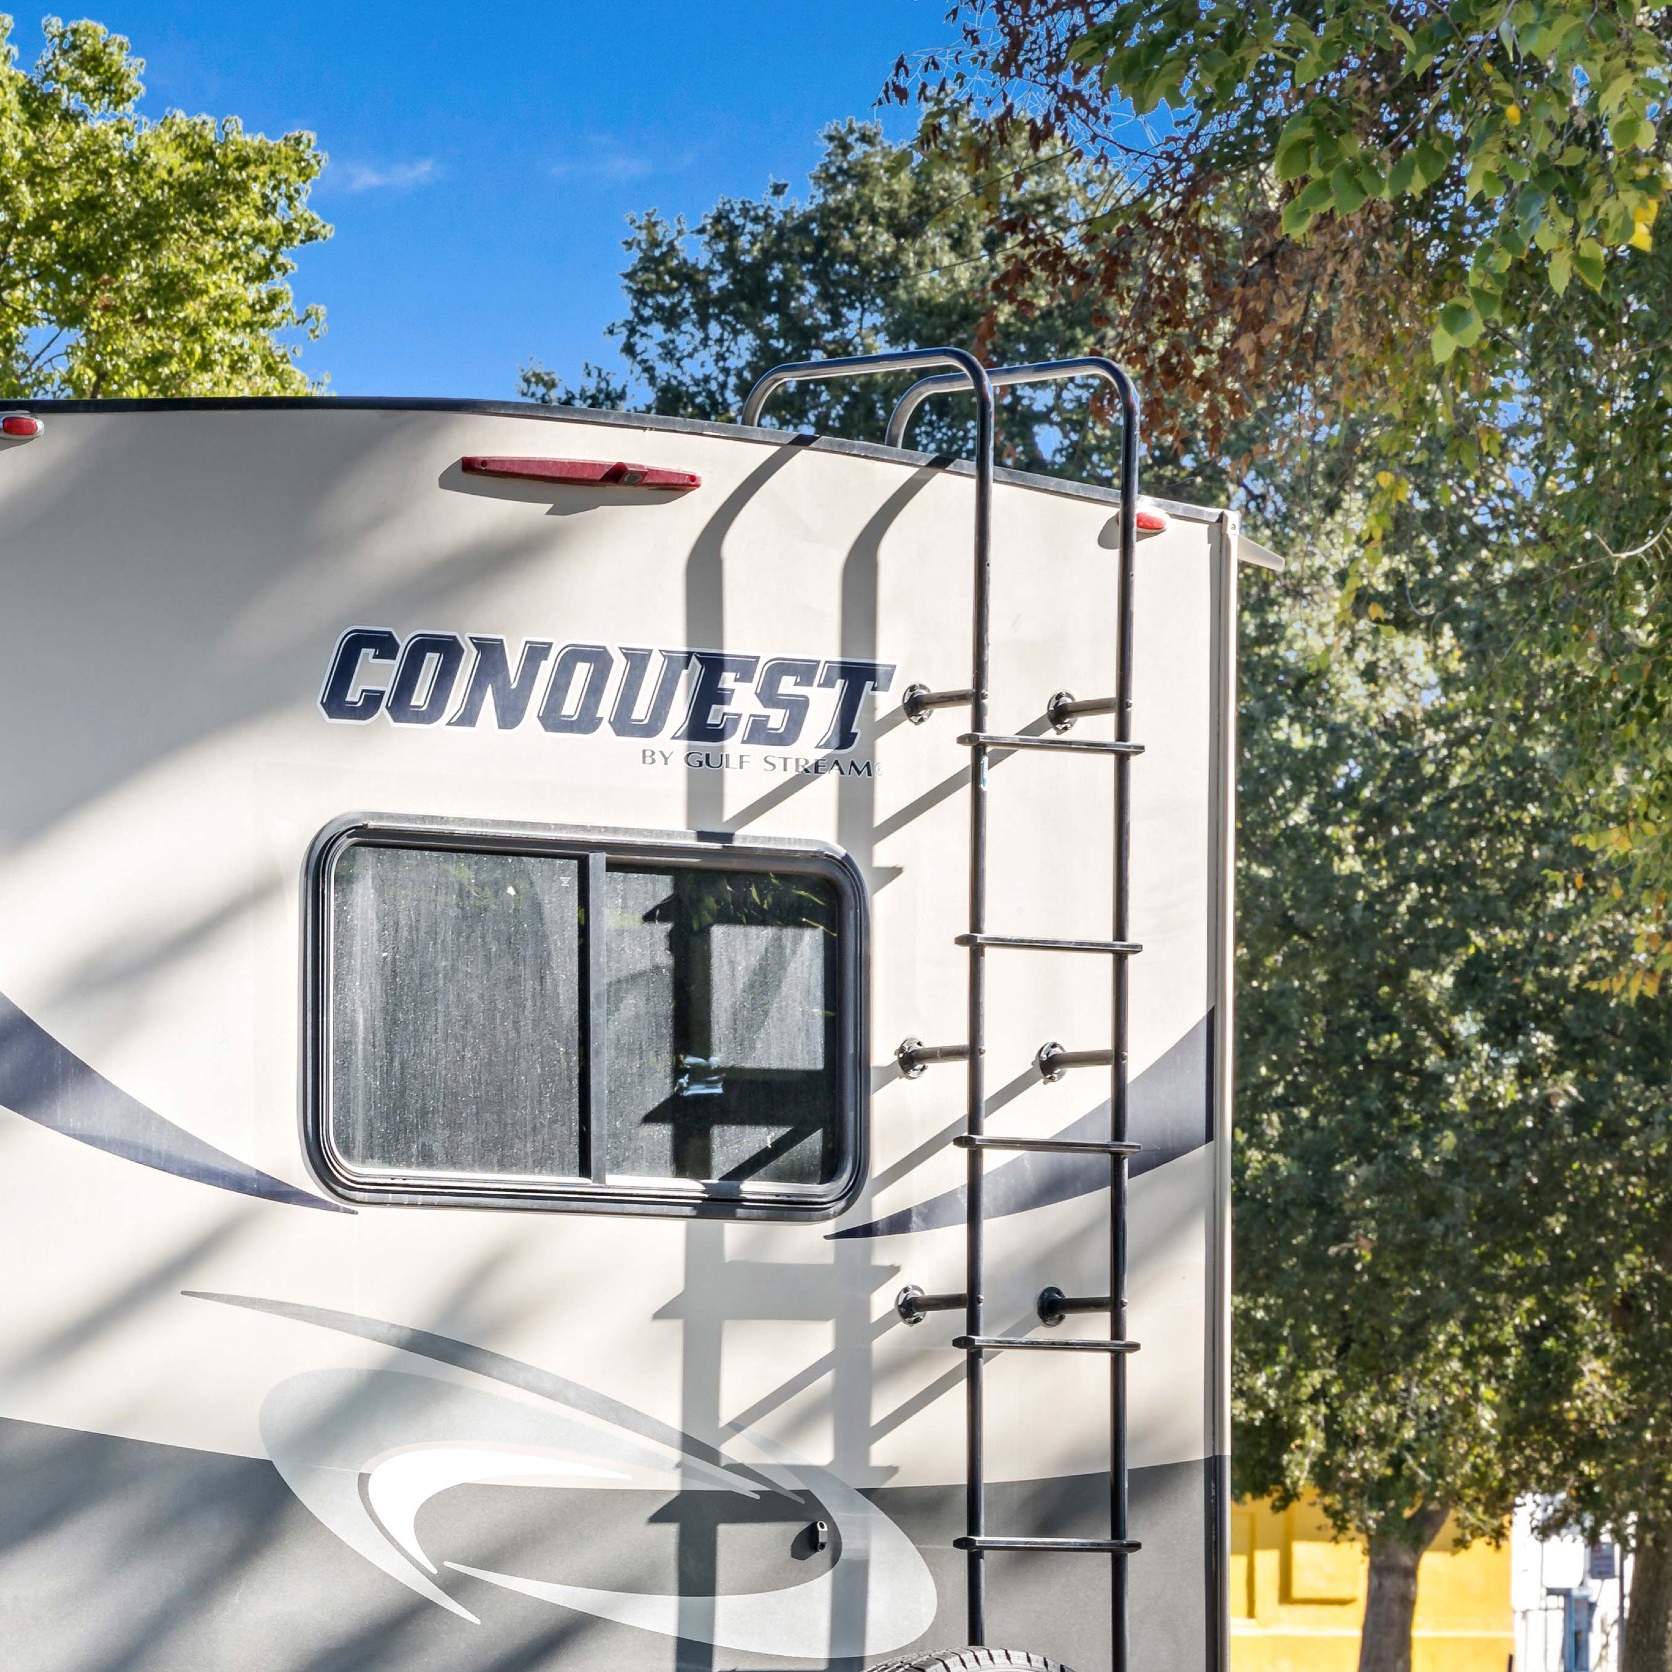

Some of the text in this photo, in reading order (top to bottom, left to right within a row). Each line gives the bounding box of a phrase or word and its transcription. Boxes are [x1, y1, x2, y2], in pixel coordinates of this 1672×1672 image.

[319, 626, 897, 752] CONQUEST
[641, 748, 673, 766] BY
[685, 751, 751, 770] GULF
